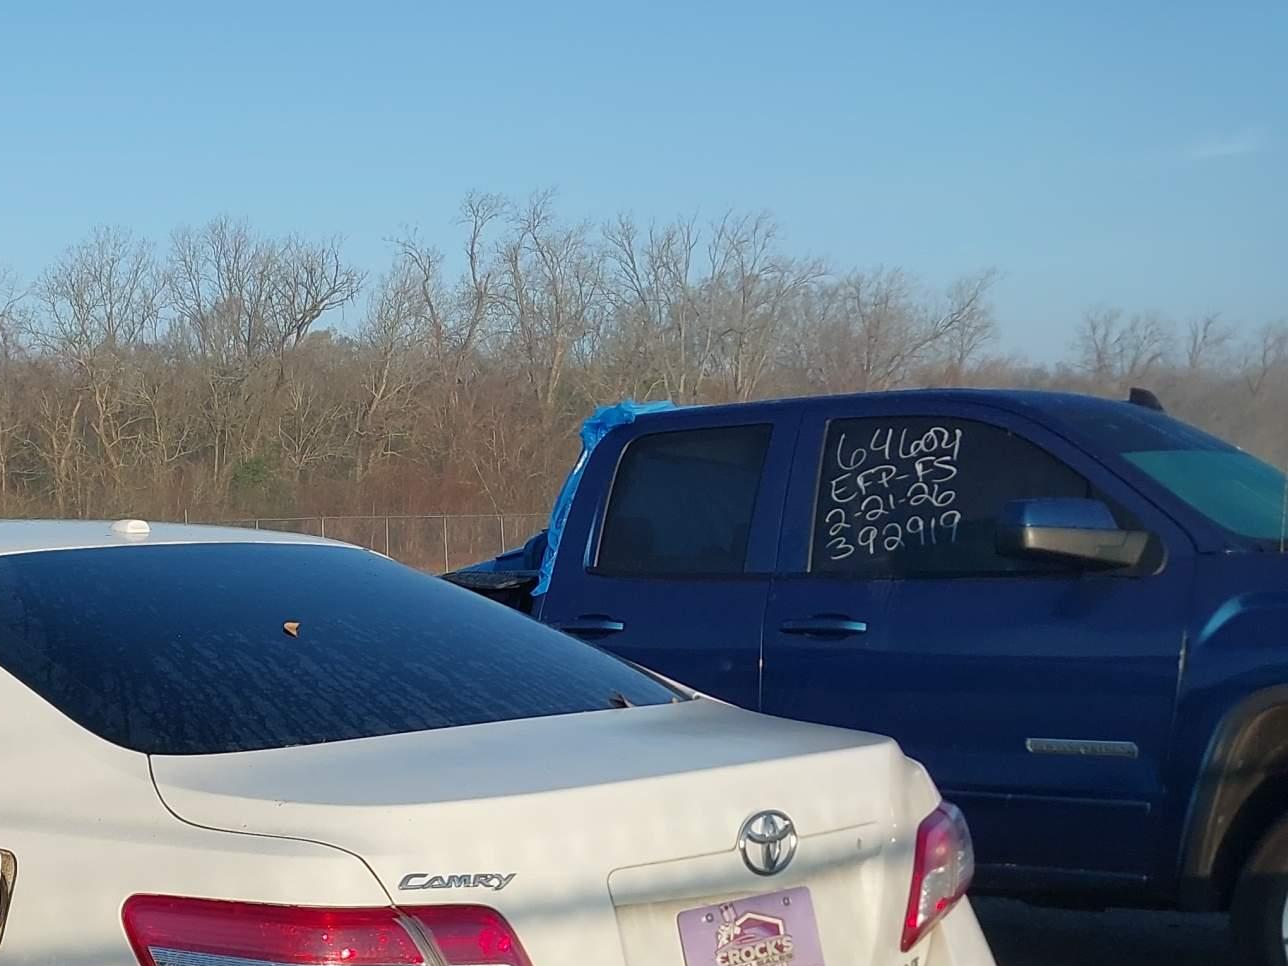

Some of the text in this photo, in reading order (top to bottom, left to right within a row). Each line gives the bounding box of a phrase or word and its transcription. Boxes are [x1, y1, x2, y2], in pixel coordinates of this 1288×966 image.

[825, 482, 956, 536] 2-21-26
[826, 510, 961, 560] 392919
[398, 873, 517, 891] CAMRY
